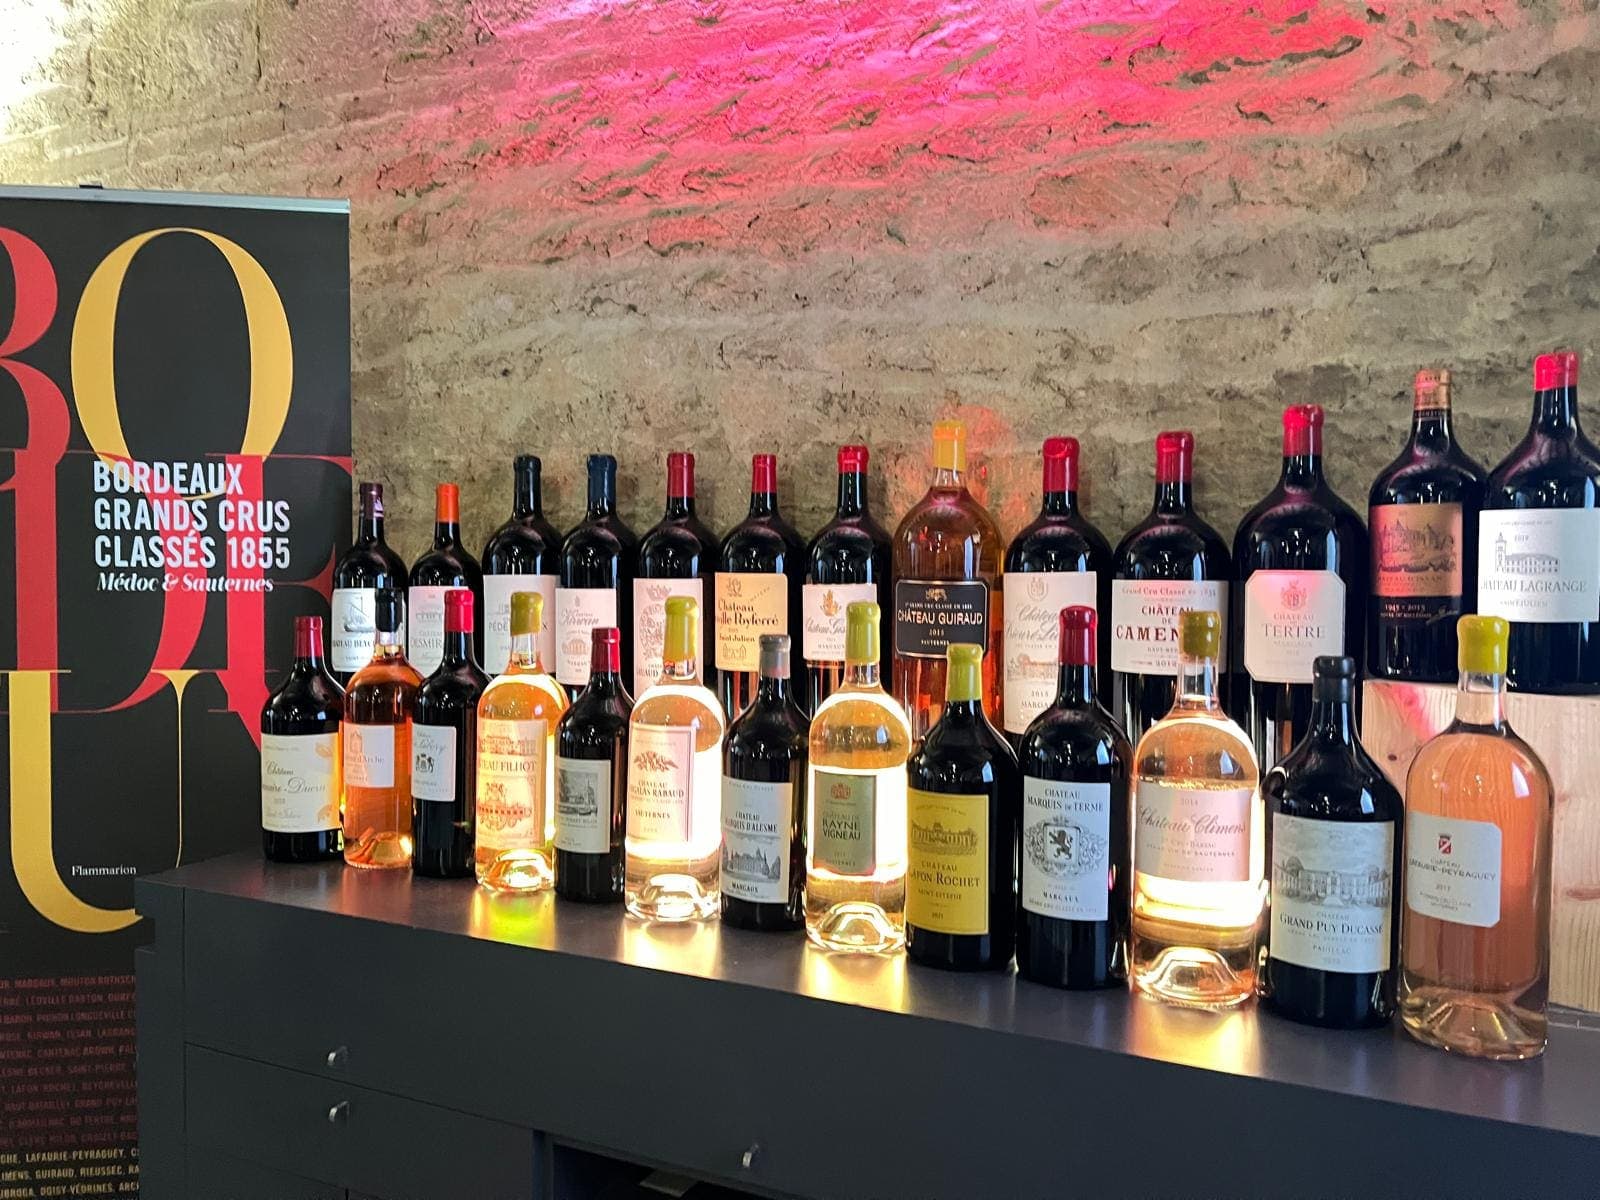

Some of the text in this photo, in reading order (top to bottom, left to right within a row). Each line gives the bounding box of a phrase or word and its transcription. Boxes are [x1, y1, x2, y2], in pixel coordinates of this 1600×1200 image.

[93, 460, 243, 495] BORDEAUX
[94, 498, 291, 533] GRANDS CRUS
[94, 528, 291, 569] CLASSÉS 1855
[97, 572, 275, 593] Médoc & Sauternes
[1519, 579, 1588, 593] LAGRANGE
[897, 607, 984, 626] CHÂTEAU GUIRAUD
[1116, 625, 1180, 642] CAMEN
[1261, 623, 1326, 639] TERTRE
[652, 789, 685, 798] RABAUD
[1027, 794, 1063, 810] MARQUIS
[1073, 802, 1104, 813] TERME
[1139, 806, 1247, 835] Château Climens
[823, 828, 862, 841] VIGNEAU
[1194, 850, 1236, 858] SAUTERNES
[71, 863, 137, 877] Flammarion
[935, 870, 980, 888] ROCHET
[1043, 891, 1079, 902] MARGAUX
[1279, 911, 1385, 936] GRAND PUY DUCASSE
